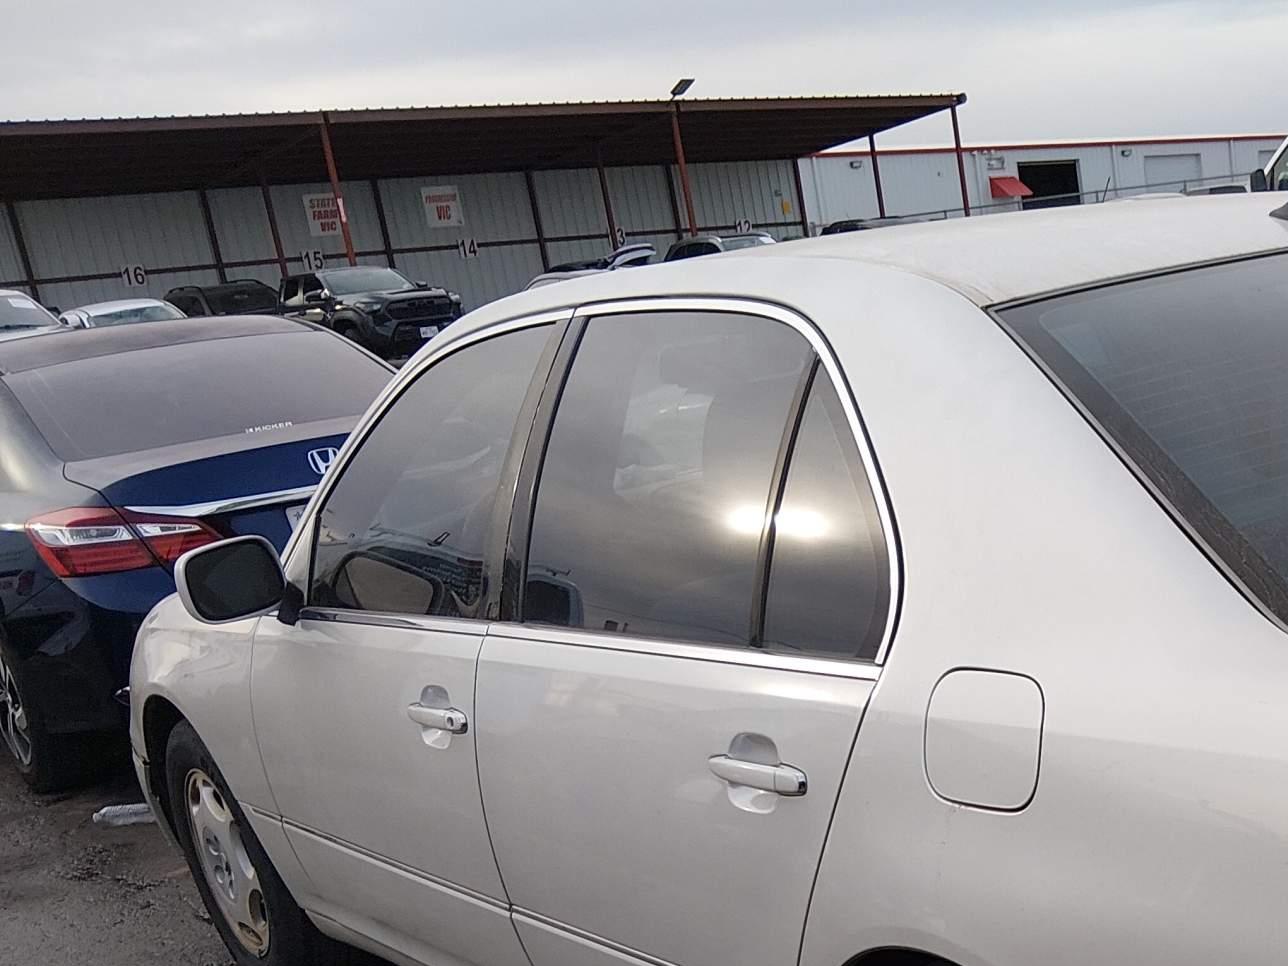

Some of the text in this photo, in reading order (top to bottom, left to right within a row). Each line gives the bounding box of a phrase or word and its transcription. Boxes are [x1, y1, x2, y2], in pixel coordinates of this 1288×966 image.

[312, 209, 338, 221] FARM
[436, 204, 451, 220] VIC
[320, 221, 337, 232] VIC
[459, 238, 477, 257] 14
[303, 250, 324, 271] 15
[123, 266, 145, 285] 16
